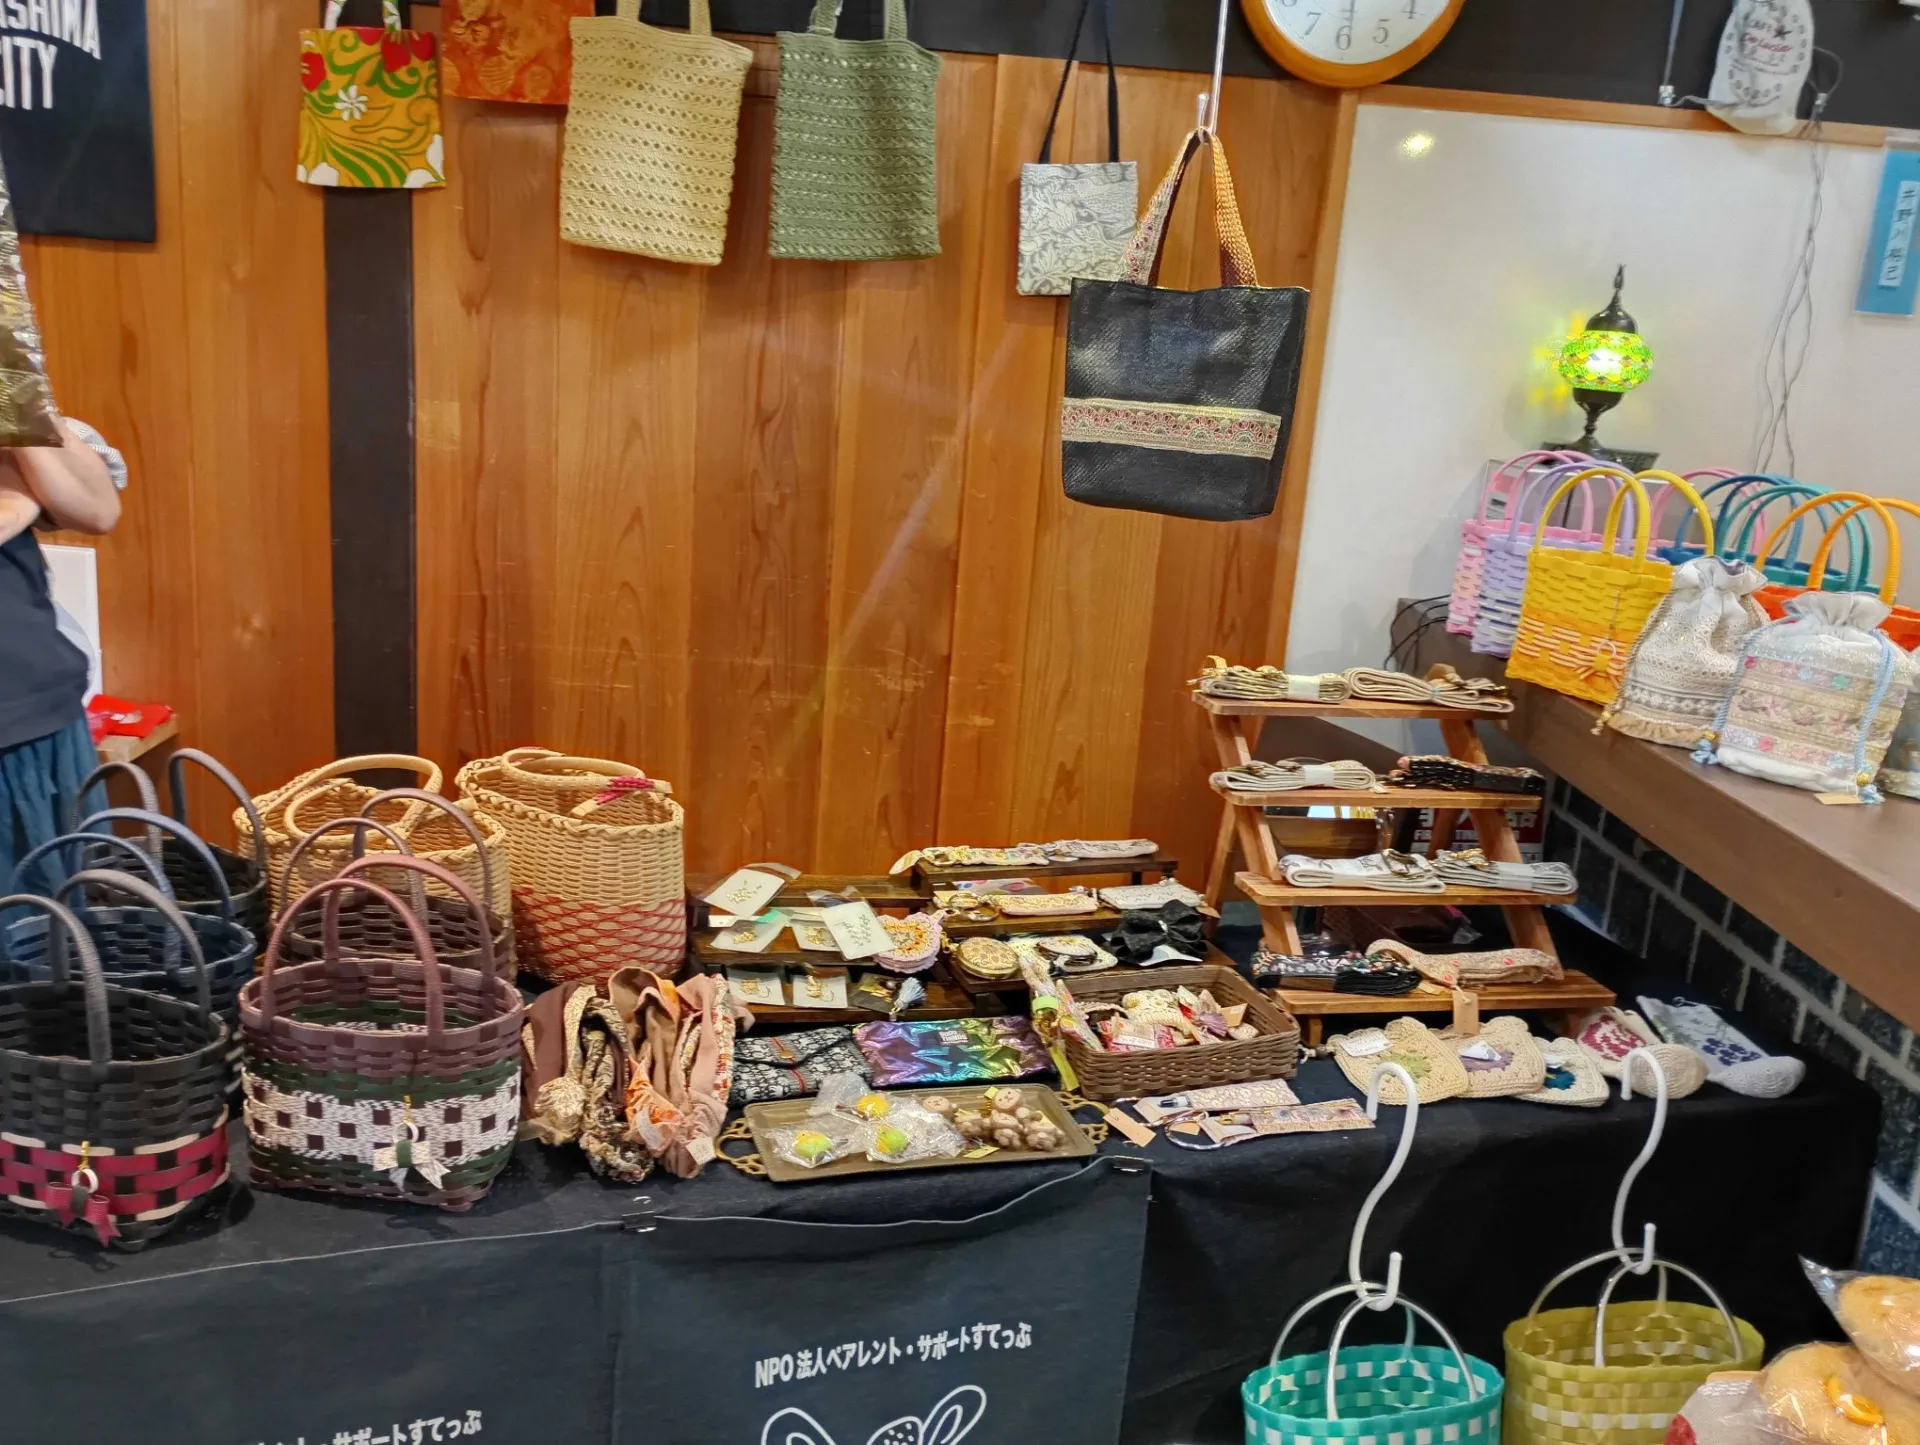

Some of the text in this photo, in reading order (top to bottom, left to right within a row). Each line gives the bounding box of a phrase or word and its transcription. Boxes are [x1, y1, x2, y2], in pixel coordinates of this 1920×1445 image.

[1304, 11, 1322, 36] 7
[1372, 18, 1391, 44] 5
[1334, 24, 1352, 51] 6
[0, 35, 58, 111] ITY
